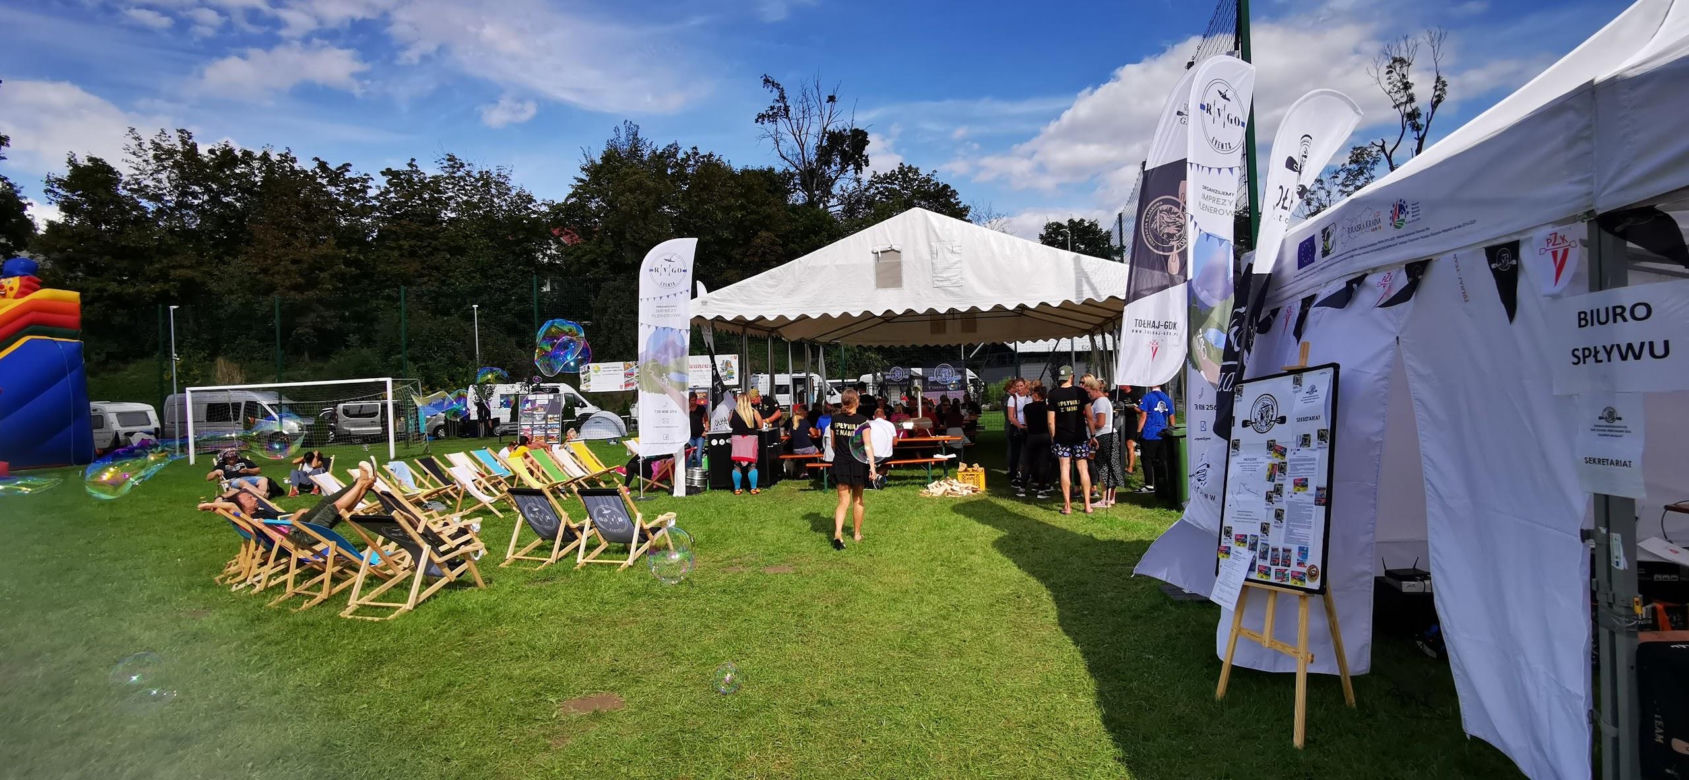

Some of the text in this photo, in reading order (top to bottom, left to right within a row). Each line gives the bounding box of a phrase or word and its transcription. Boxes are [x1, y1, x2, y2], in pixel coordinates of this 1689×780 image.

[1134, 318, 1177, 331] TOŁHAJ-GDK
[1578, 302, 1652, 328] BIURO
[1571, 339, 1670, 366] SPŁYWU
[1584, 456, 1633, 468] SEKRETARIAT
